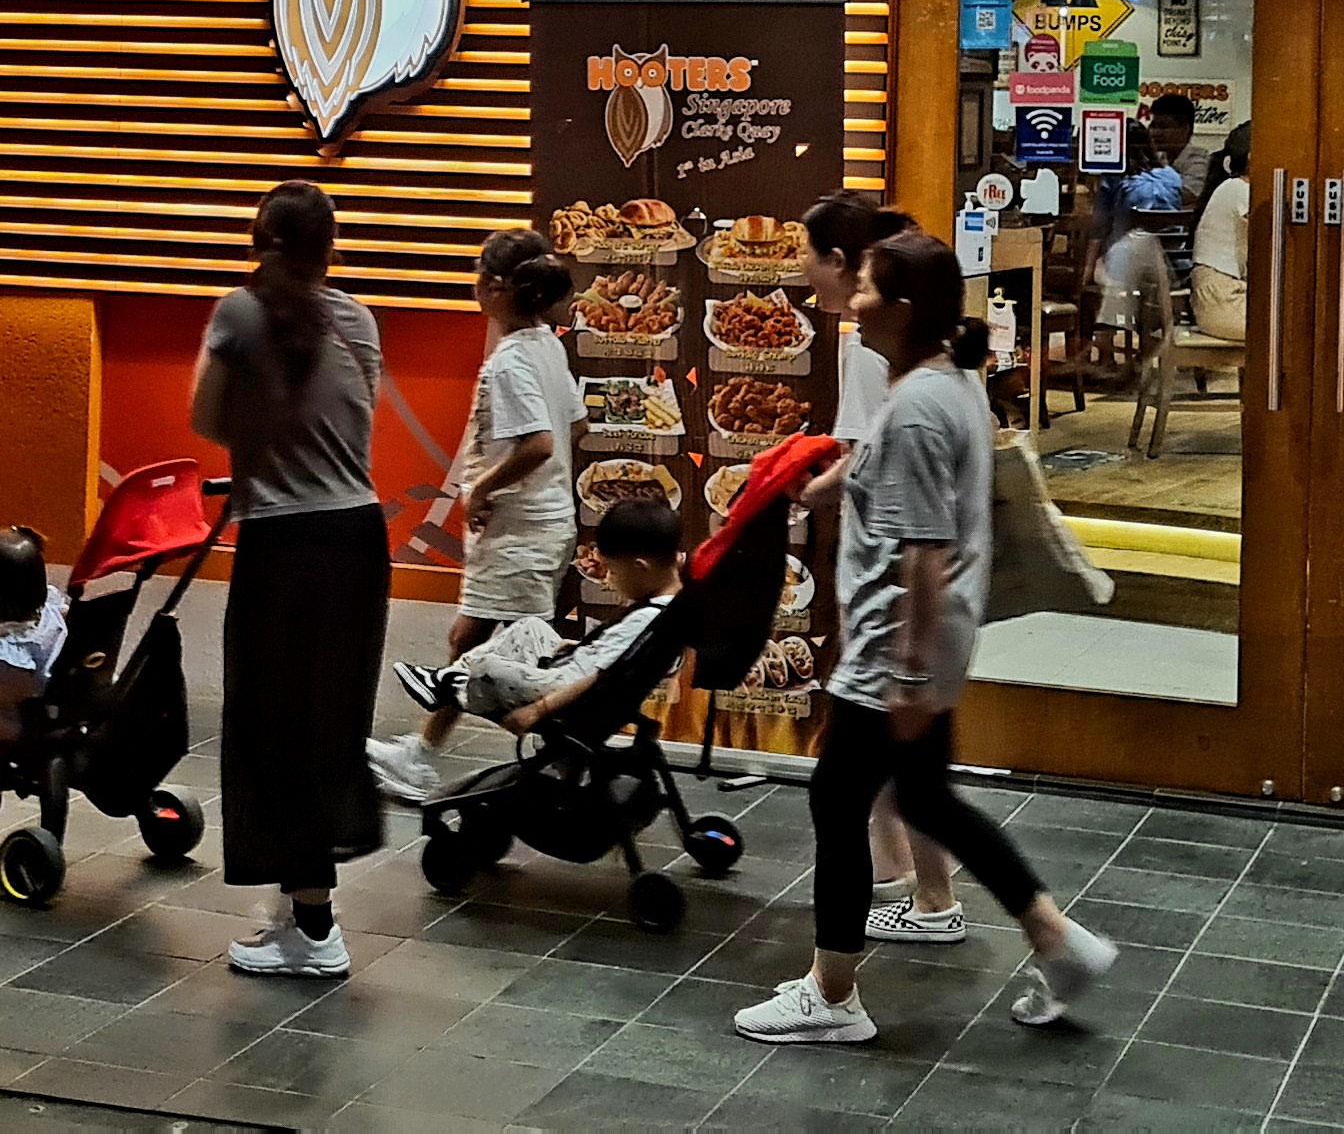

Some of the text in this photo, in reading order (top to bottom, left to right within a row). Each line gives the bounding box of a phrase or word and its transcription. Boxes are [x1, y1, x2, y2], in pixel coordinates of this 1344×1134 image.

[1034, 13, 1102, 32] BUMPS
[587, 55, 752, 92] HOOTERS
[1093, 62, 1126, 74] Grab
[1026, 85, 1071, 95] foodpanda
[1093, 75, 1126, 87] Food
[681, 93, 792, 122] Singapore
[681, 119, 782, 144] Clarke Quay
[718, 144, 756, 170] Asia
[1296, 180, 1305, 220] PUSH
[1328, 181, 1337, 221] PUSH
